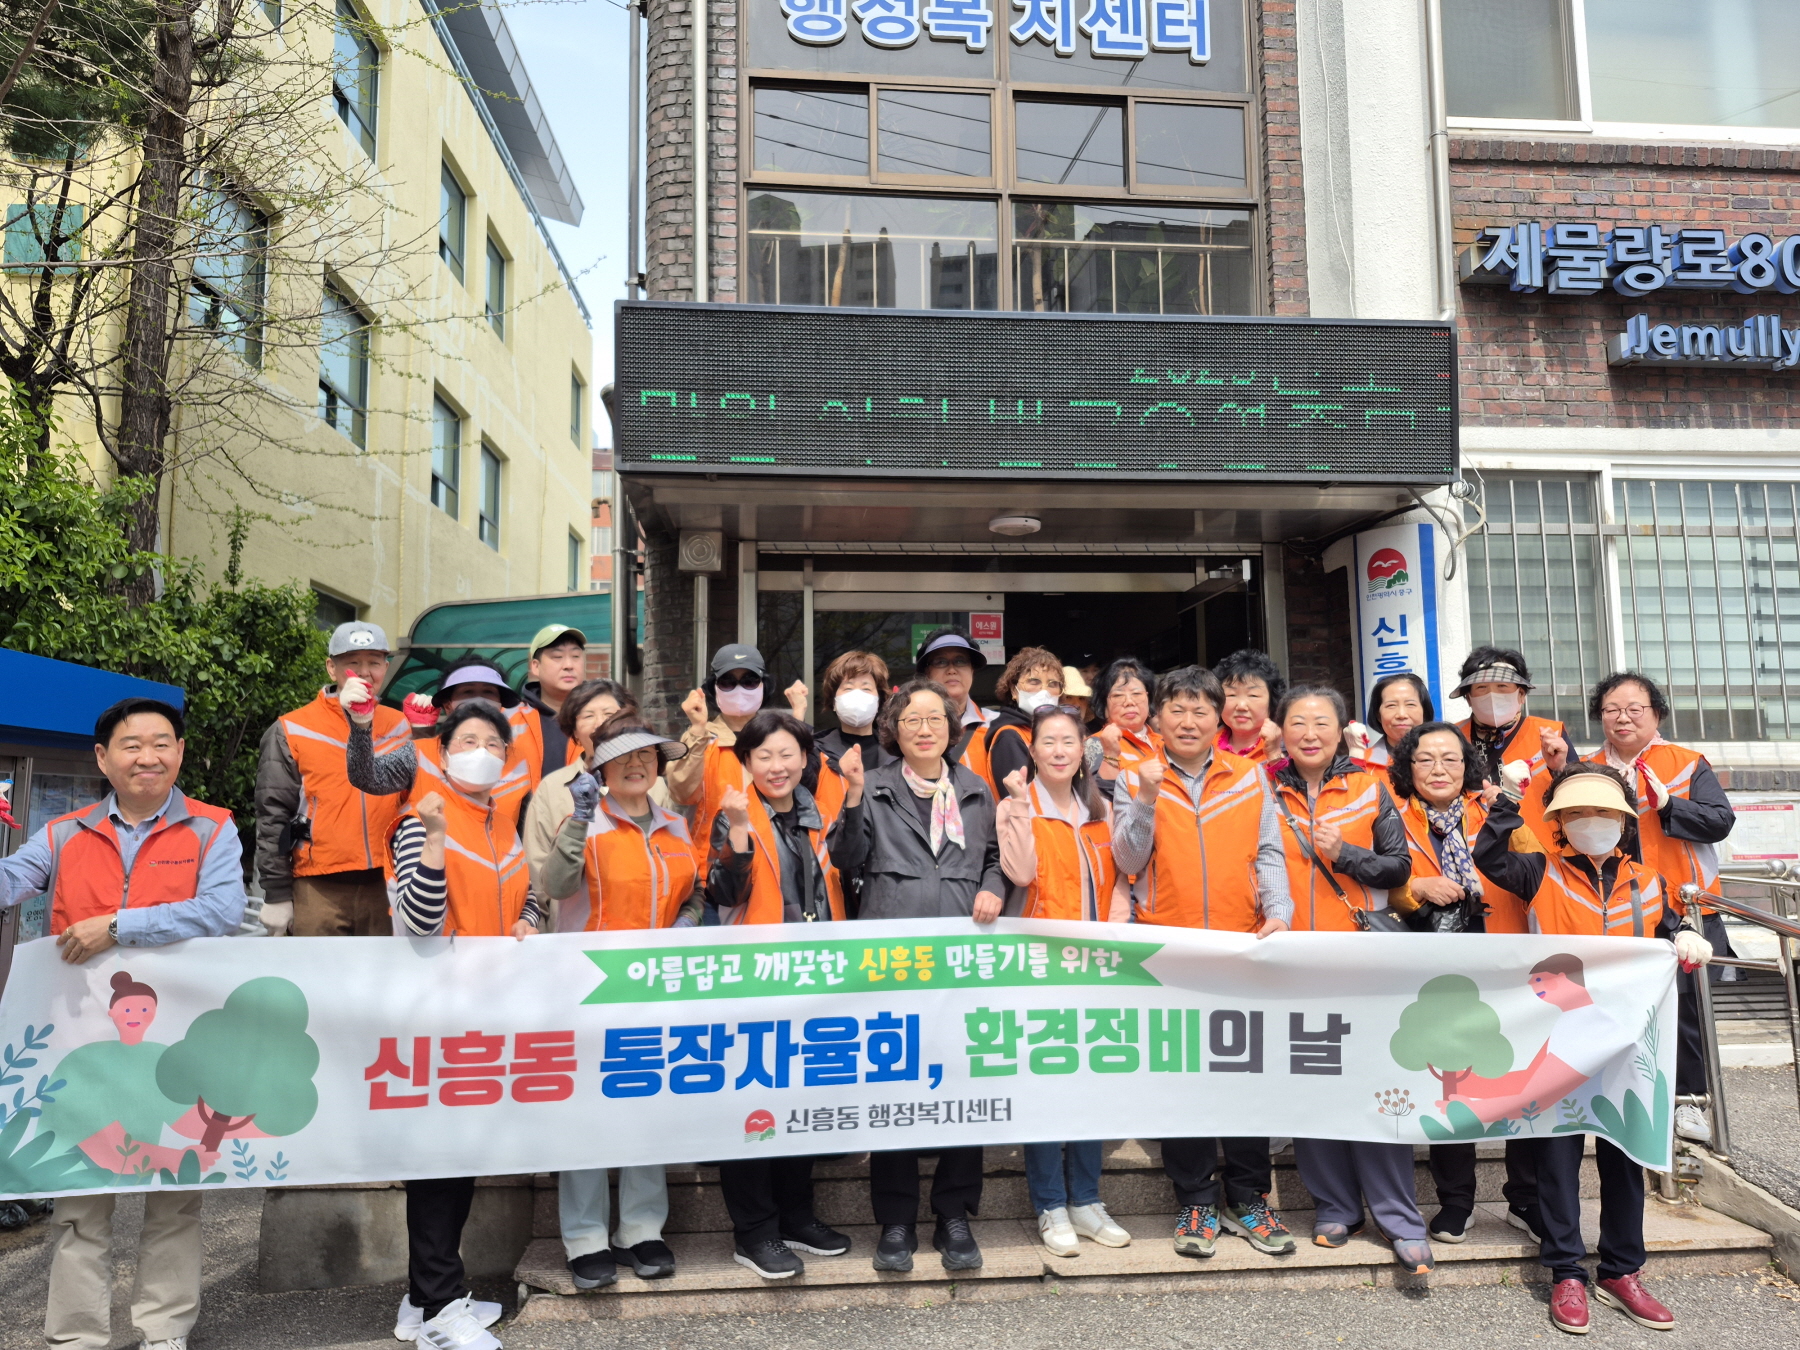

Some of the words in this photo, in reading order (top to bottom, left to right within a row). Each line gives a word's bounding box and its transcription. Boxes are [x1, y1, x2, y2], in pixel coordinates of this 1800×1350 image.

[976, 621, 997, 631] 에스원
[626, 953, 744, 994] 아름답고
[753, 948, 849, 988] 깨끗한
[858, 944, 936, 983] 신흥동
[945, 942, 1050, 980] 만들기를
[1060, 943, 1124, 978] 위한
[364, 1030, 578, 1111] 신흥동
[599, 1010, 944, 1100] 통장자율회,
[965, 1006, 1264, 1078] 환경정비의
[1289, 1012, 1351, 1076] 날
[785, 1106, 859, 1134] 신흥동
[868, 1097, 1012, 1129] 행정복지센터
